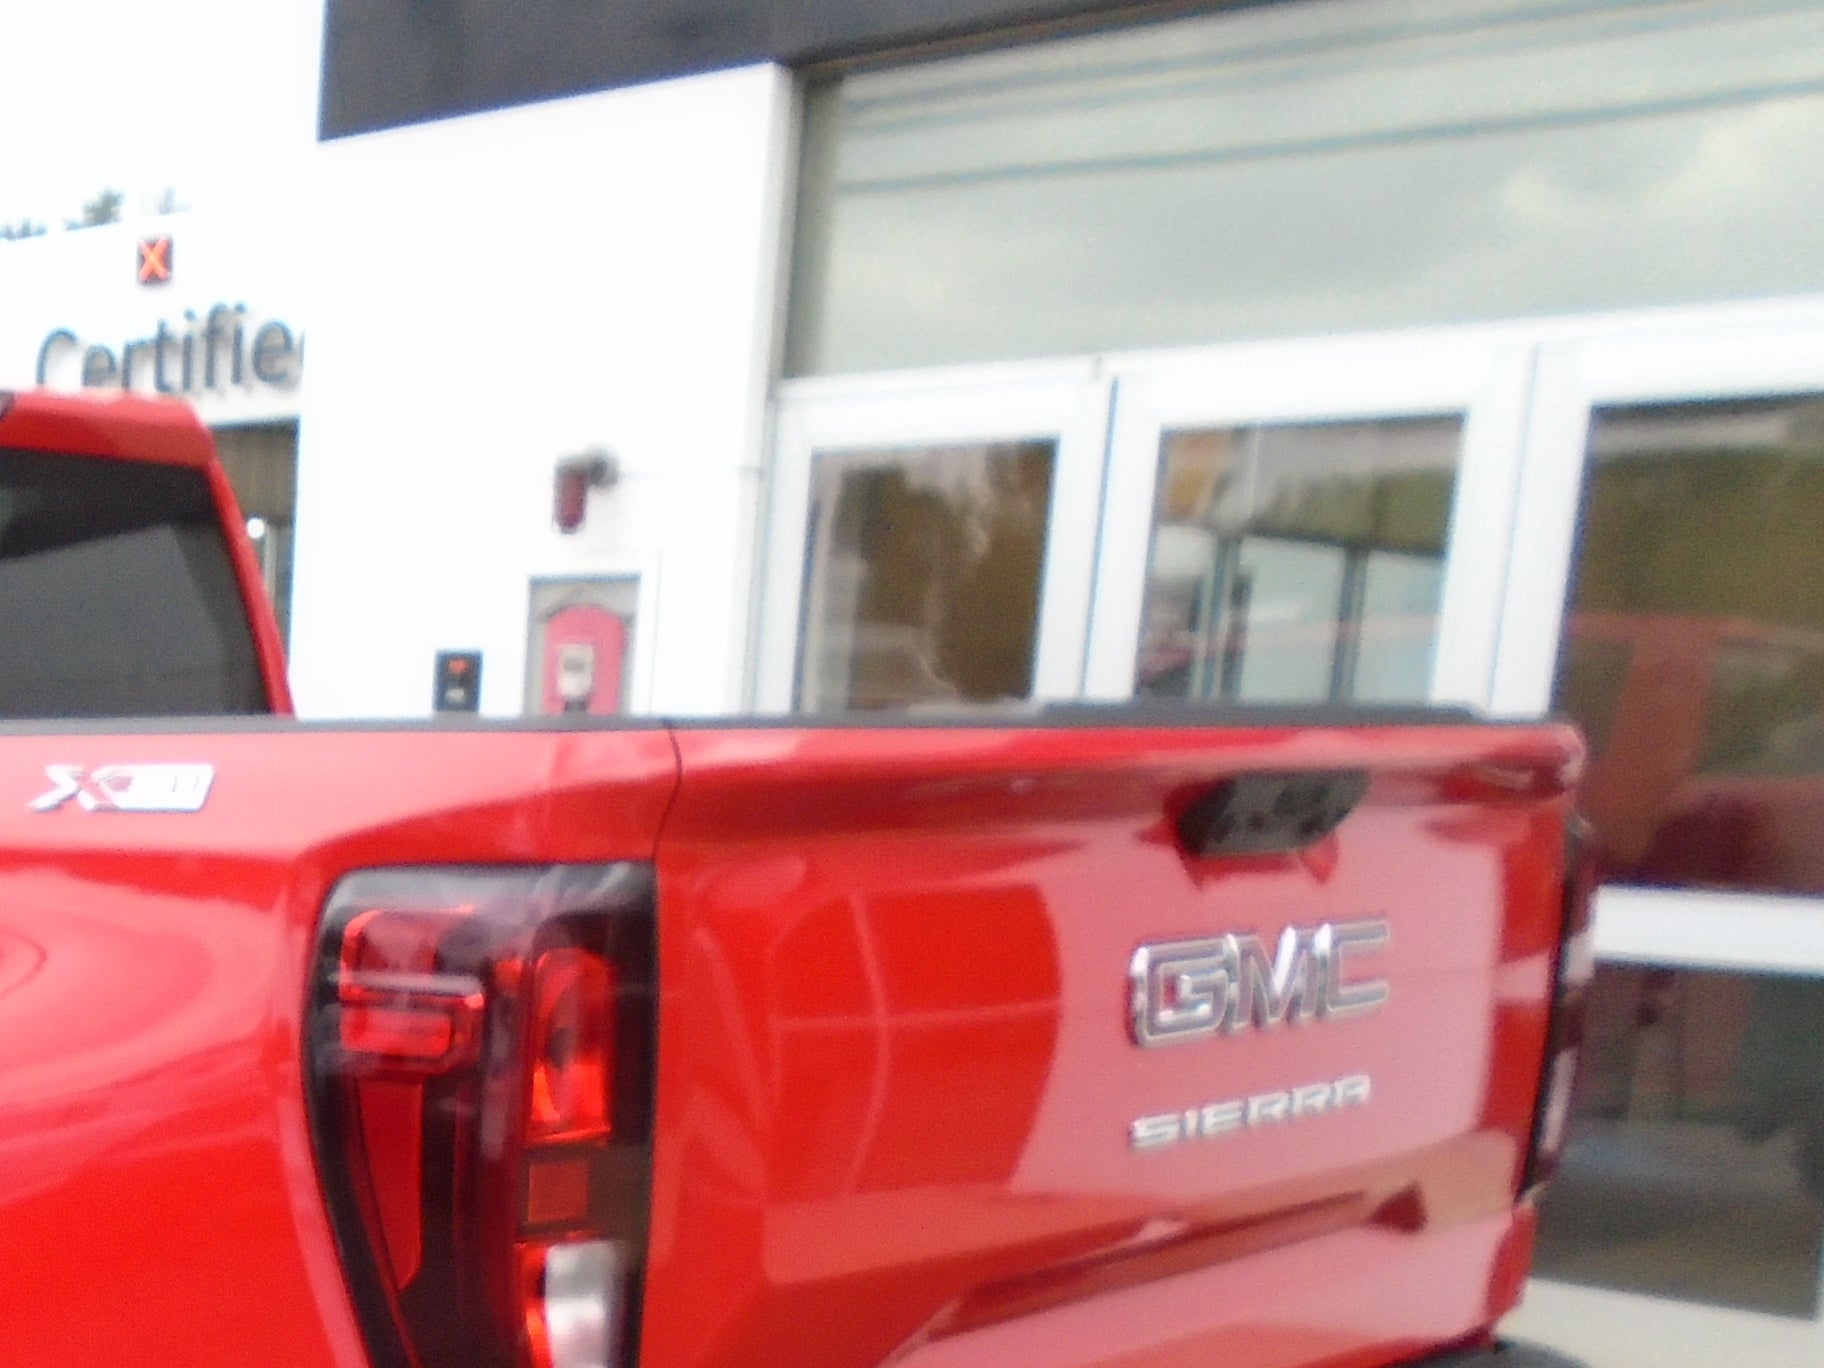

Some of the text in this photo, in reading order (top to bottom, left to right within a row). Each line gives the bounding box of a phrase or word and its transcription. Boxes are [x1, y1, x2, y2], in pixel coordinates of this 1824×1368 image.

[35, 301, 305, 394] Certifie
[1127, 920, 1390, 1047] GMC
[1130, 1072, 1371, 1151] SIERRA
